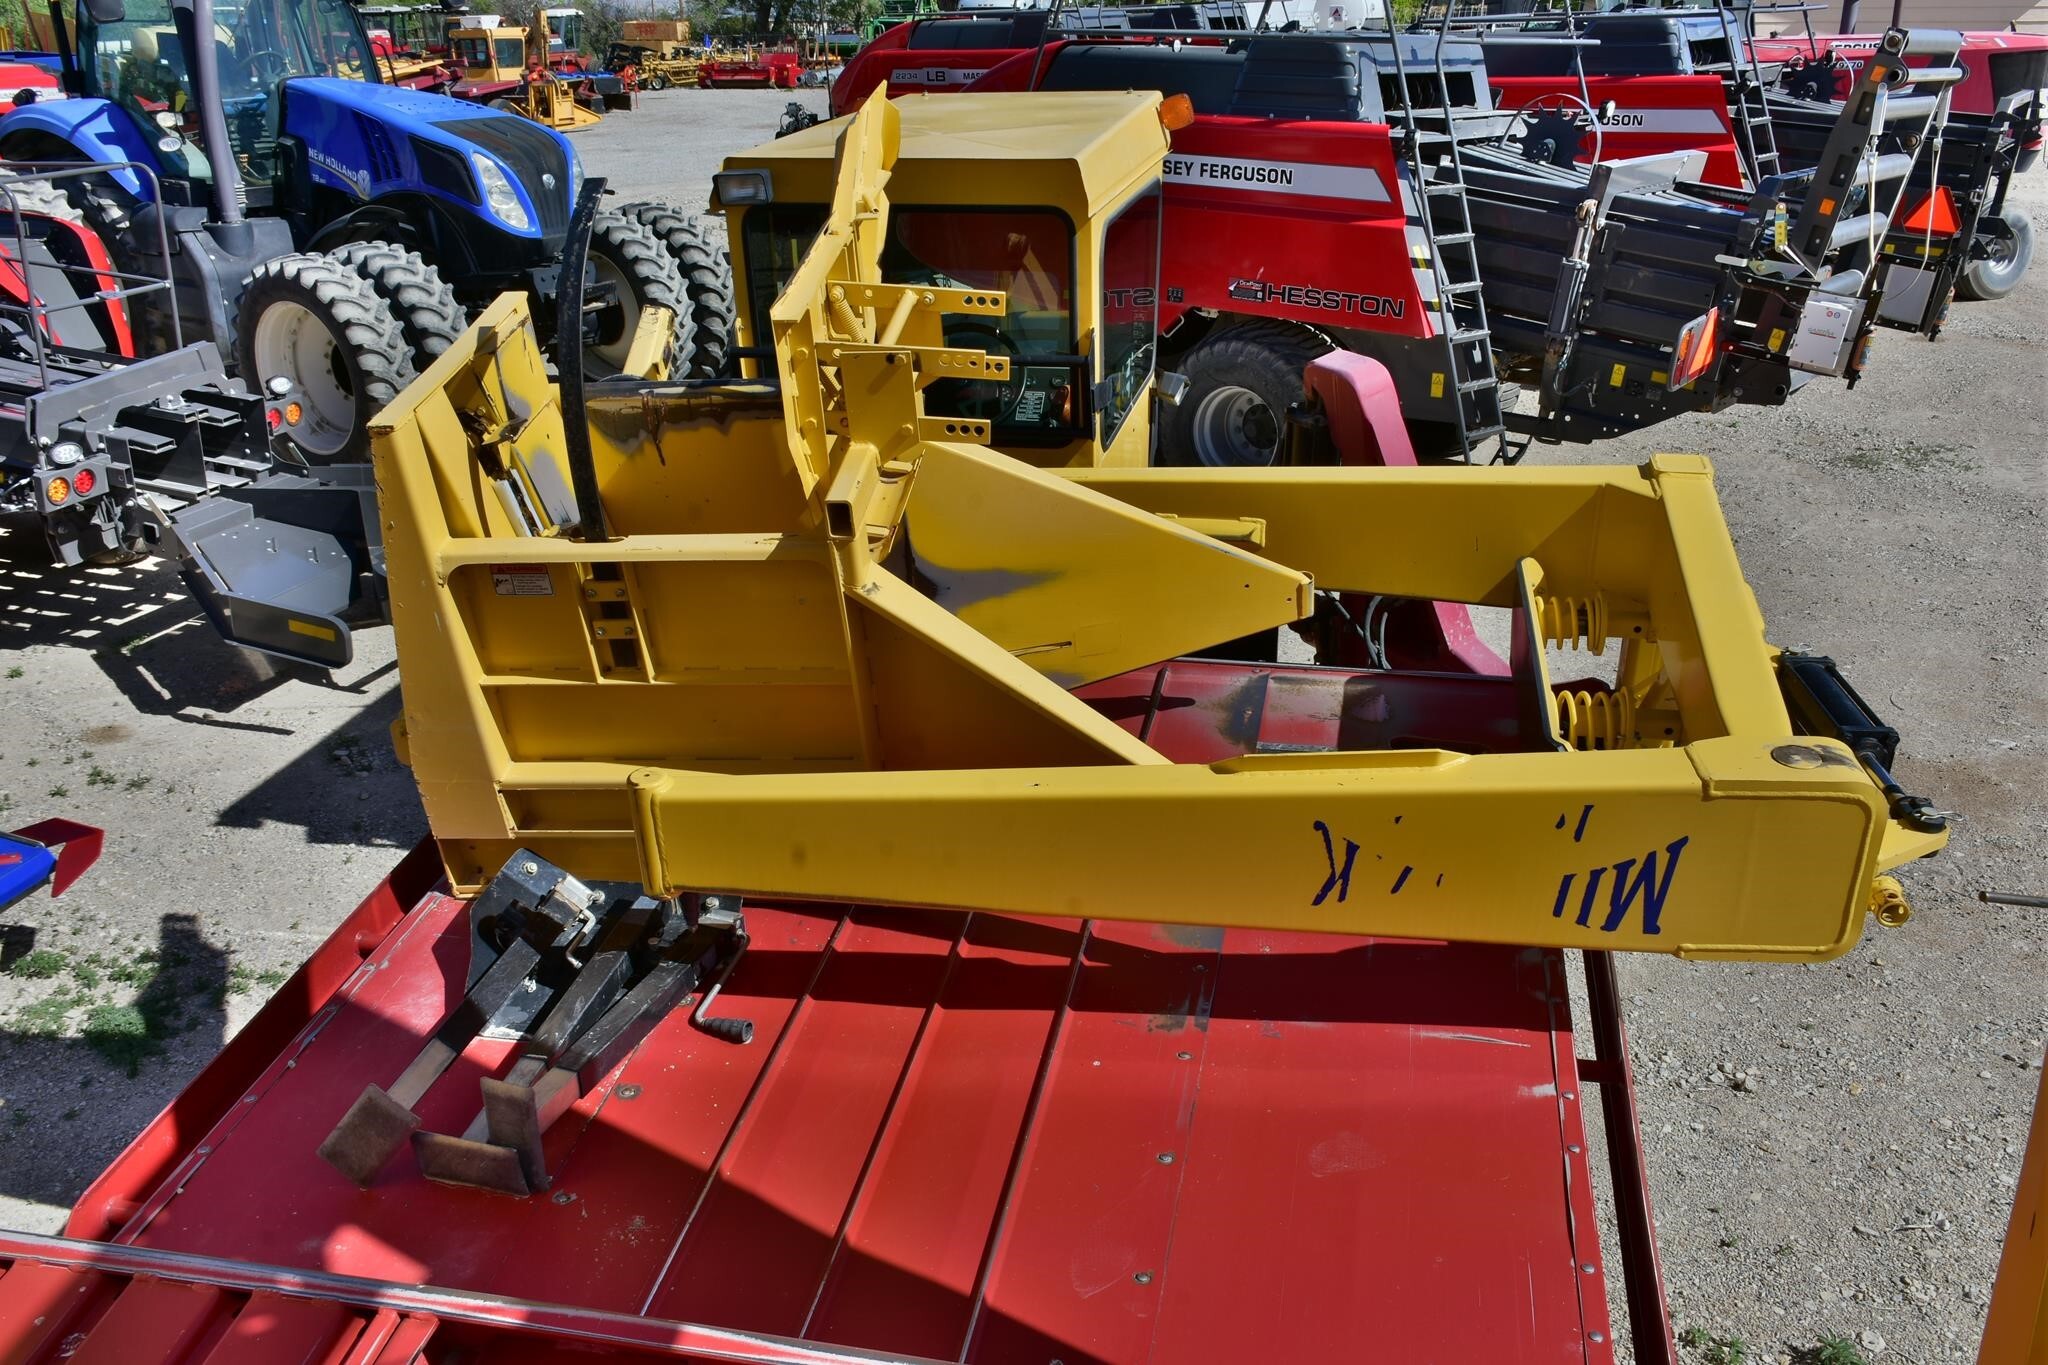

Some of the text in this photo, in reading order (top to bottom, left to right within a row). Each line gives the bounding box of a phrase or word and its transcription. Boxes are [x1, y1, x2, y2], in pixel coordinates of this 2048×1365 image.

[895, 72, 918, 80] 2234
[926, 70, 946, 82] LB
[308, 147, 357, 182] NEW HOLLAND
[1200, 163, 1293, 185] FERGUSON
[1266, 283, 1405, 319] HESSTON
